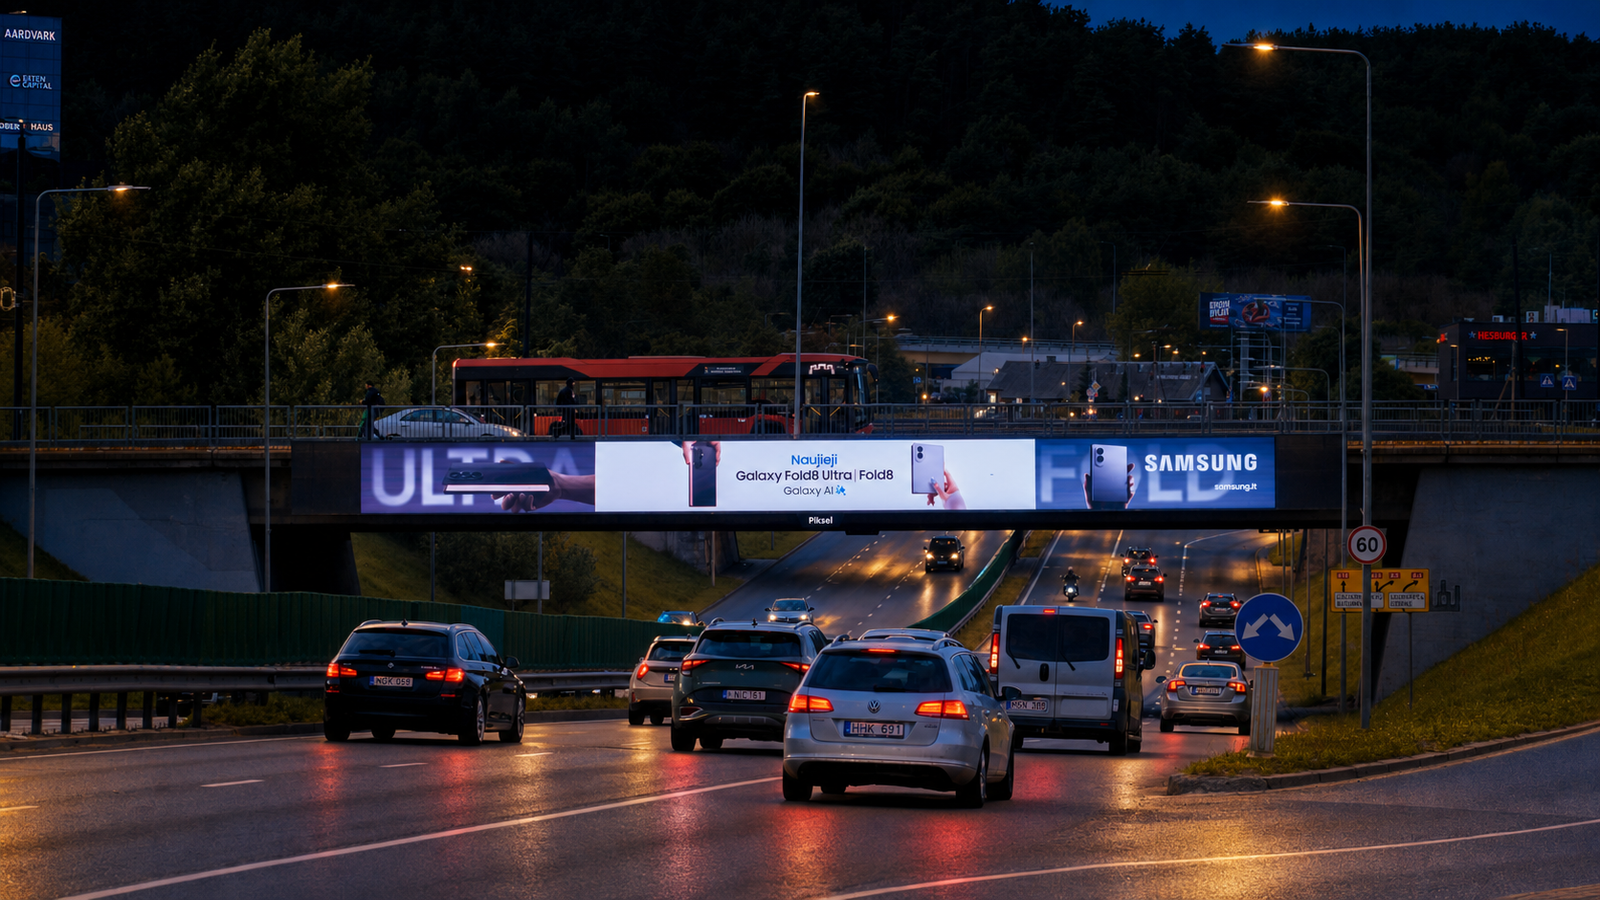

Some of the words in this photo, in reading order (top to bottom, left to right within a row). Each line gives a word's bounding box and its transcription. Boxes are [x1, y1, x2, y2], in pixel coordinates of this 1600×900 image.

[4, 28, 56, 41] AARDVARK
[22, 81, 53, 90] CAPITAL
[30, 123, 54, 131] HAUS
[1477, 330, 1528, 341] HESBURGR
[791, 454, 838, 468] Naujieji
[1144, 453, 1258, 472] SAMSUNG
[735, 470, 783, 484] Galaxy
[784, 469, 820, 482] Fold8
[821, 469, 853, 482] Ultra
[858, 469, 894, 481] Fold8
[783, 486, 822, 497] Galaxy
[823, 486, 834, 496] AI
[1214, 482, 1258, 492] samsung.lt
[808, 515, 834, 525] Piksel
[1356, 537, 1379, 553] 60
[851, 722, 875, 734] HHK
[880, 724, 901, 735] 691
